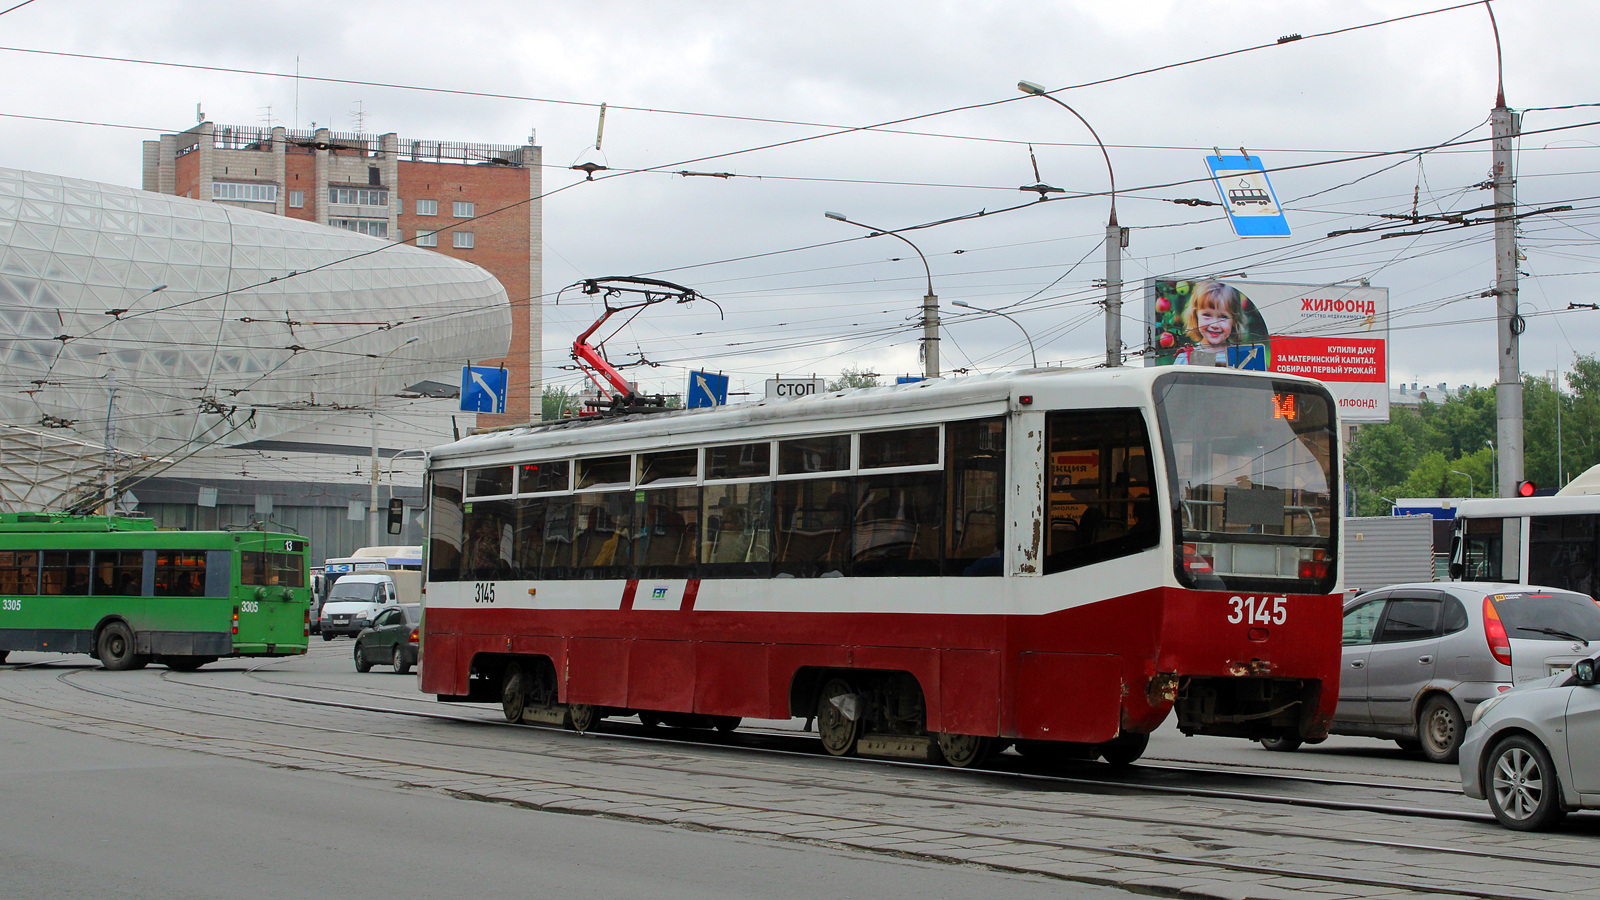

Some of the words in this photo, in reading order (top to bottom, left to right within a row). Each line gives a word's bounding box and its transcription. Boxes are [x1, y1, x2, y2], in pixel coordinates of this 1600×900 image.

[1301, 298, 1376, 316] ЖИЛФОНД
[1327, 345, 1356, 354] КУПИЛИ
[1357, 346, 1376, 355] ДАЧУ
[1277, 354, 1287, 362] ЗА
[1287, 354, 1340, 364] МАТЕРИНСКИЙ
[1341, 356, 1376, 365] КАПИТАЛ.
[1276, 364, 1312, 373] СОБИРАЮ
[1312, 365, 1343, 374] ПЕРВЫЙ
[1343, 366, 1377, 375] УРОЖАЙ!
[776, 383, 815, 397] СТОП
[1271, 393, 1297, 420] 14
[285, 540, 293, 552] 13
[325, 564, 350, 573] 13
[475, 582, 495, 603] 3145
[2, 599, 22, 611] 3305
[241, 600, 259, 613] 3305
[1227, 596, 1287, 625] 3145
